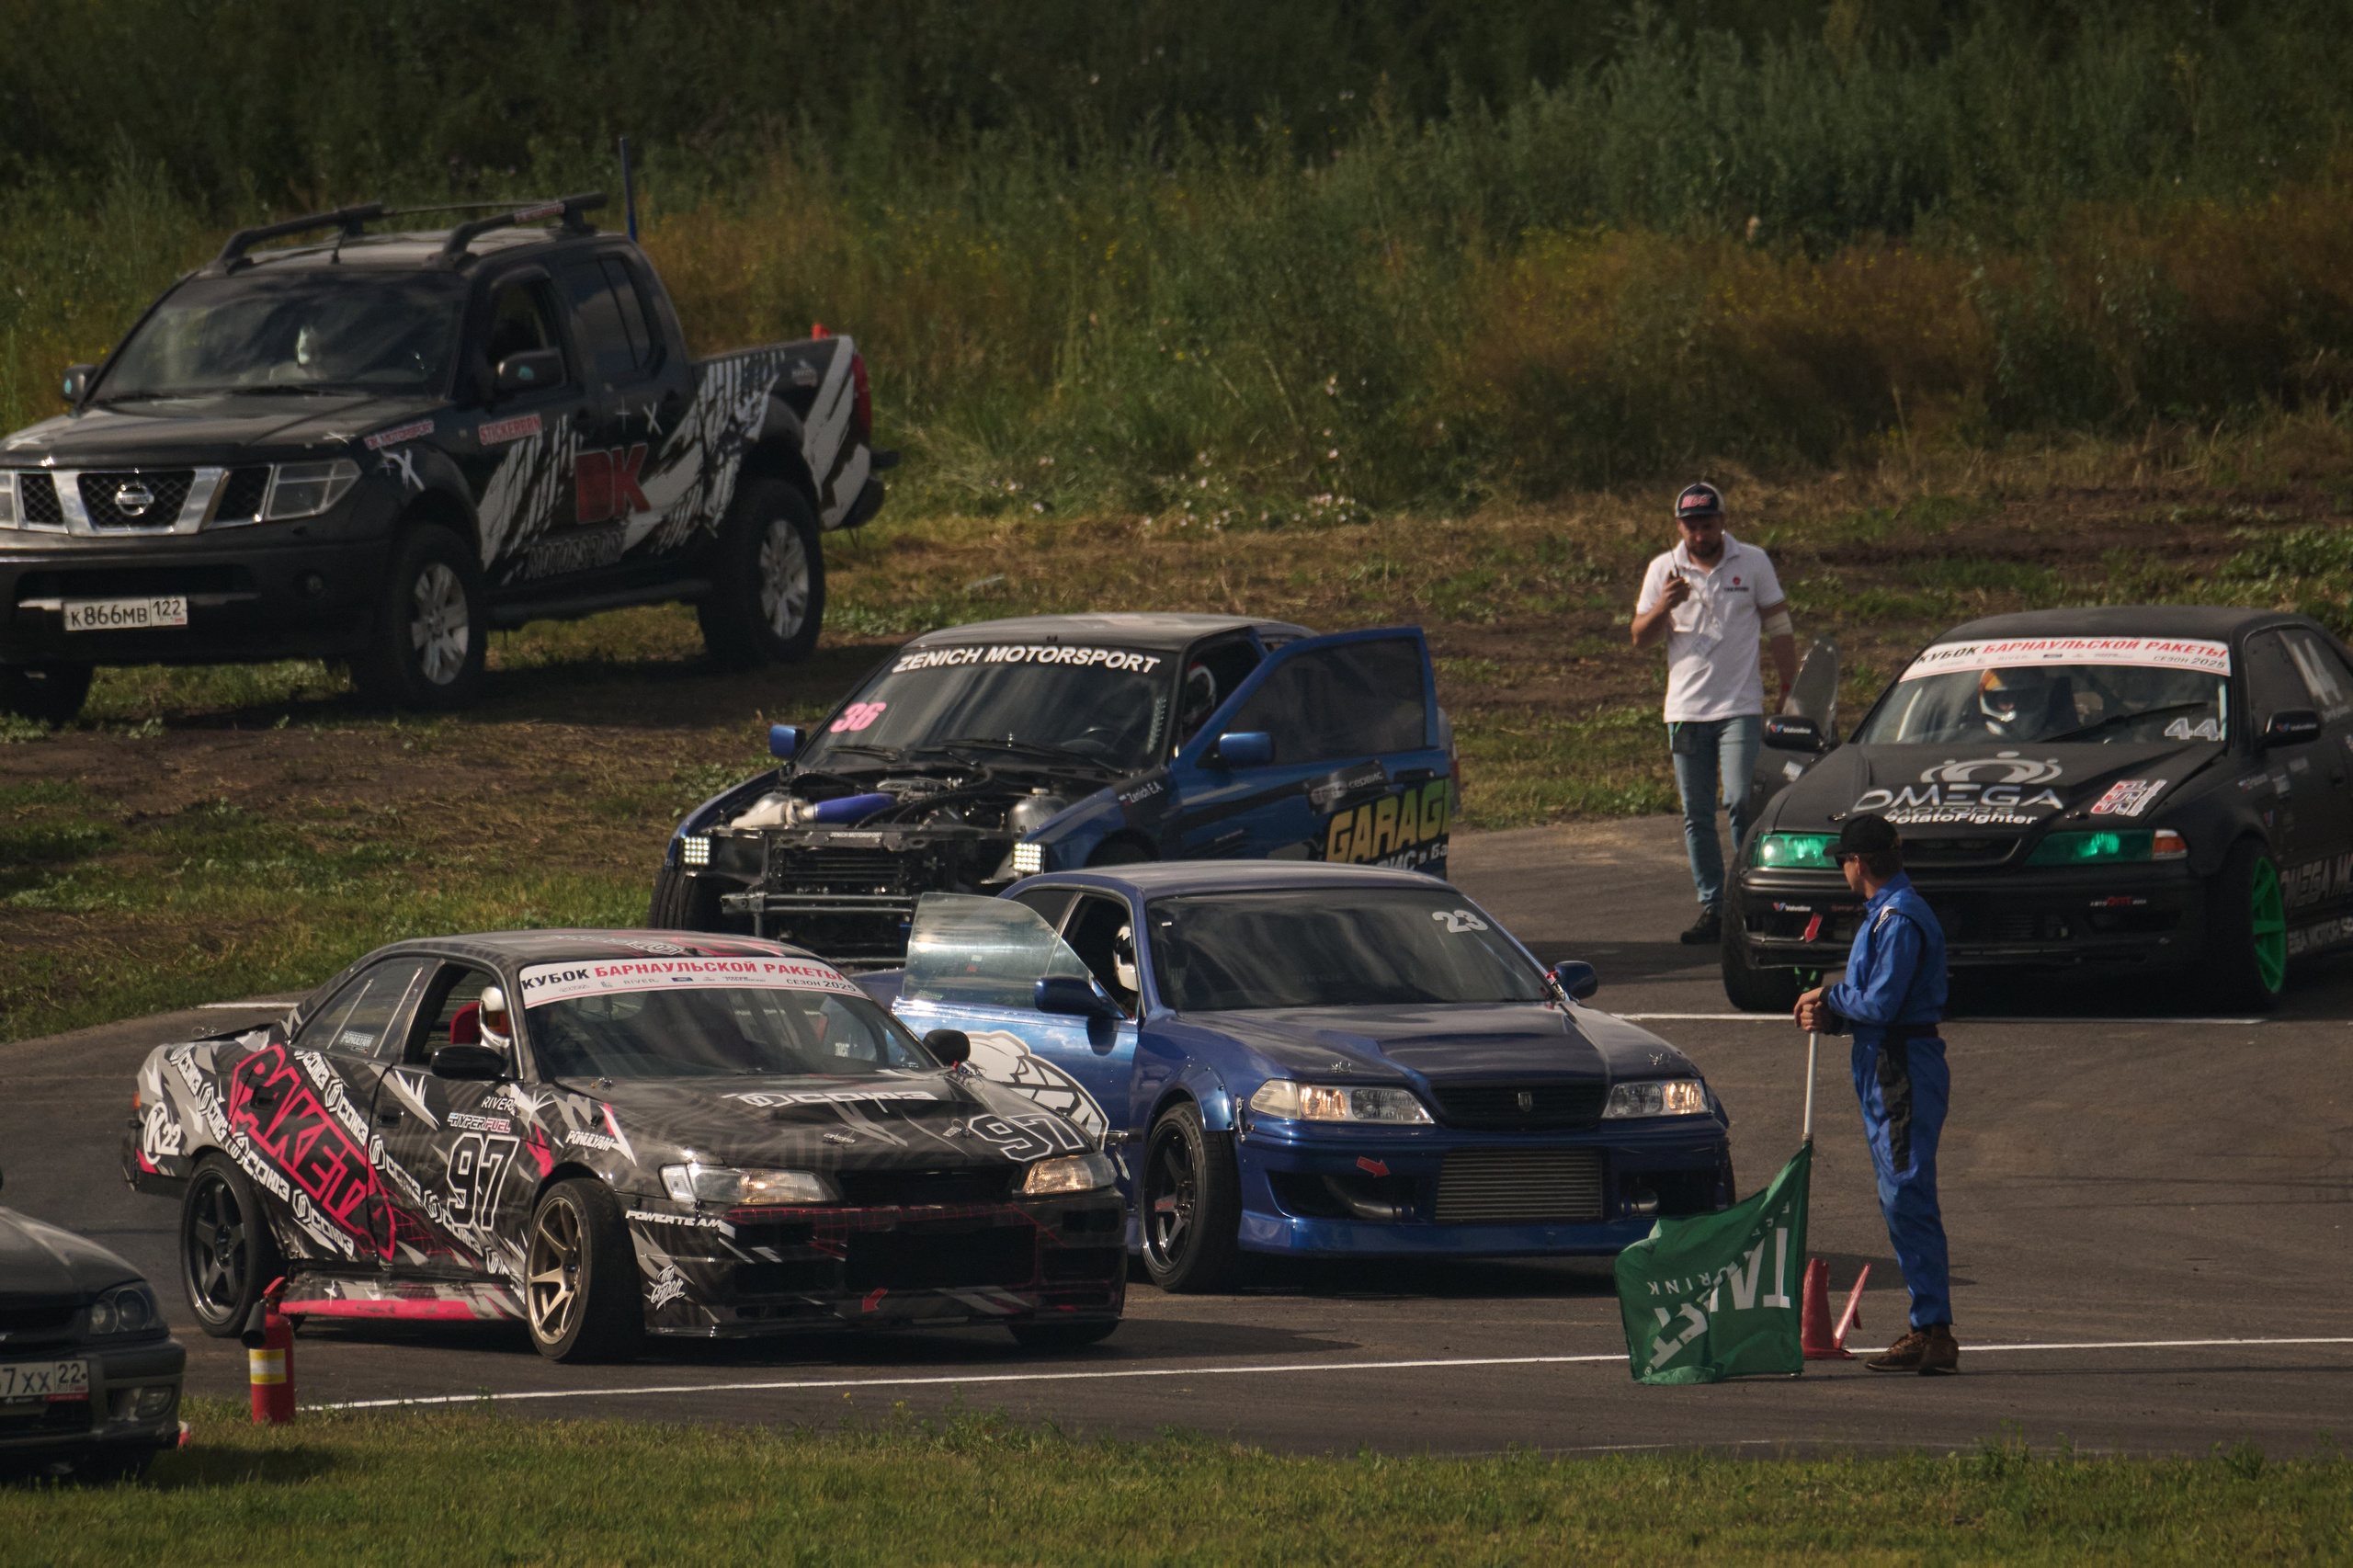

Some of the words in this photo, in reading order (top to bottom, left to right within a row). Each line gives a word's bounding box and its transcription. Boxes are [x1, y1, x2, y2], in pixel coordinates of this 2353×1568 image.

[575, 441, 650, 524] DK
[153, 600, 181, 617] 122
[892, 647, 983, 674] ZENICH
[983, 645, 1161, 674] MOTORSPORT
[1916, 646, 1981, 664] КУБОК
[1983, 637, 2141, 653] БАРНАУЛЬСКОЙ
[2145, 642, 2229, 658] РАКЕТЫ
[2154, 655, 2189, 664] СЕЗОН
[2190, 658, 2226, 669] 2025
[830, 702, 887, 733] 36
[2165, 718, 2223, 741] 44
[1432, 910, 1488, 933] 23
[521, 968, 589, 991] КУБОК
[595, 960, 757, 977] БАРНАУЛЬСКОЙ
[764, 964, 843, 982] РАКЕТЫ
[786, 979, 821, 987] СЕЗОН
[824, 981, 857, 993] 2025
[481, 1096, 515, 1111] RIVER
[968, 1113, 1086, 1162] 97
[447, 1132, 520, 1232] 97
[58, 1363, 80, 1383] 22
